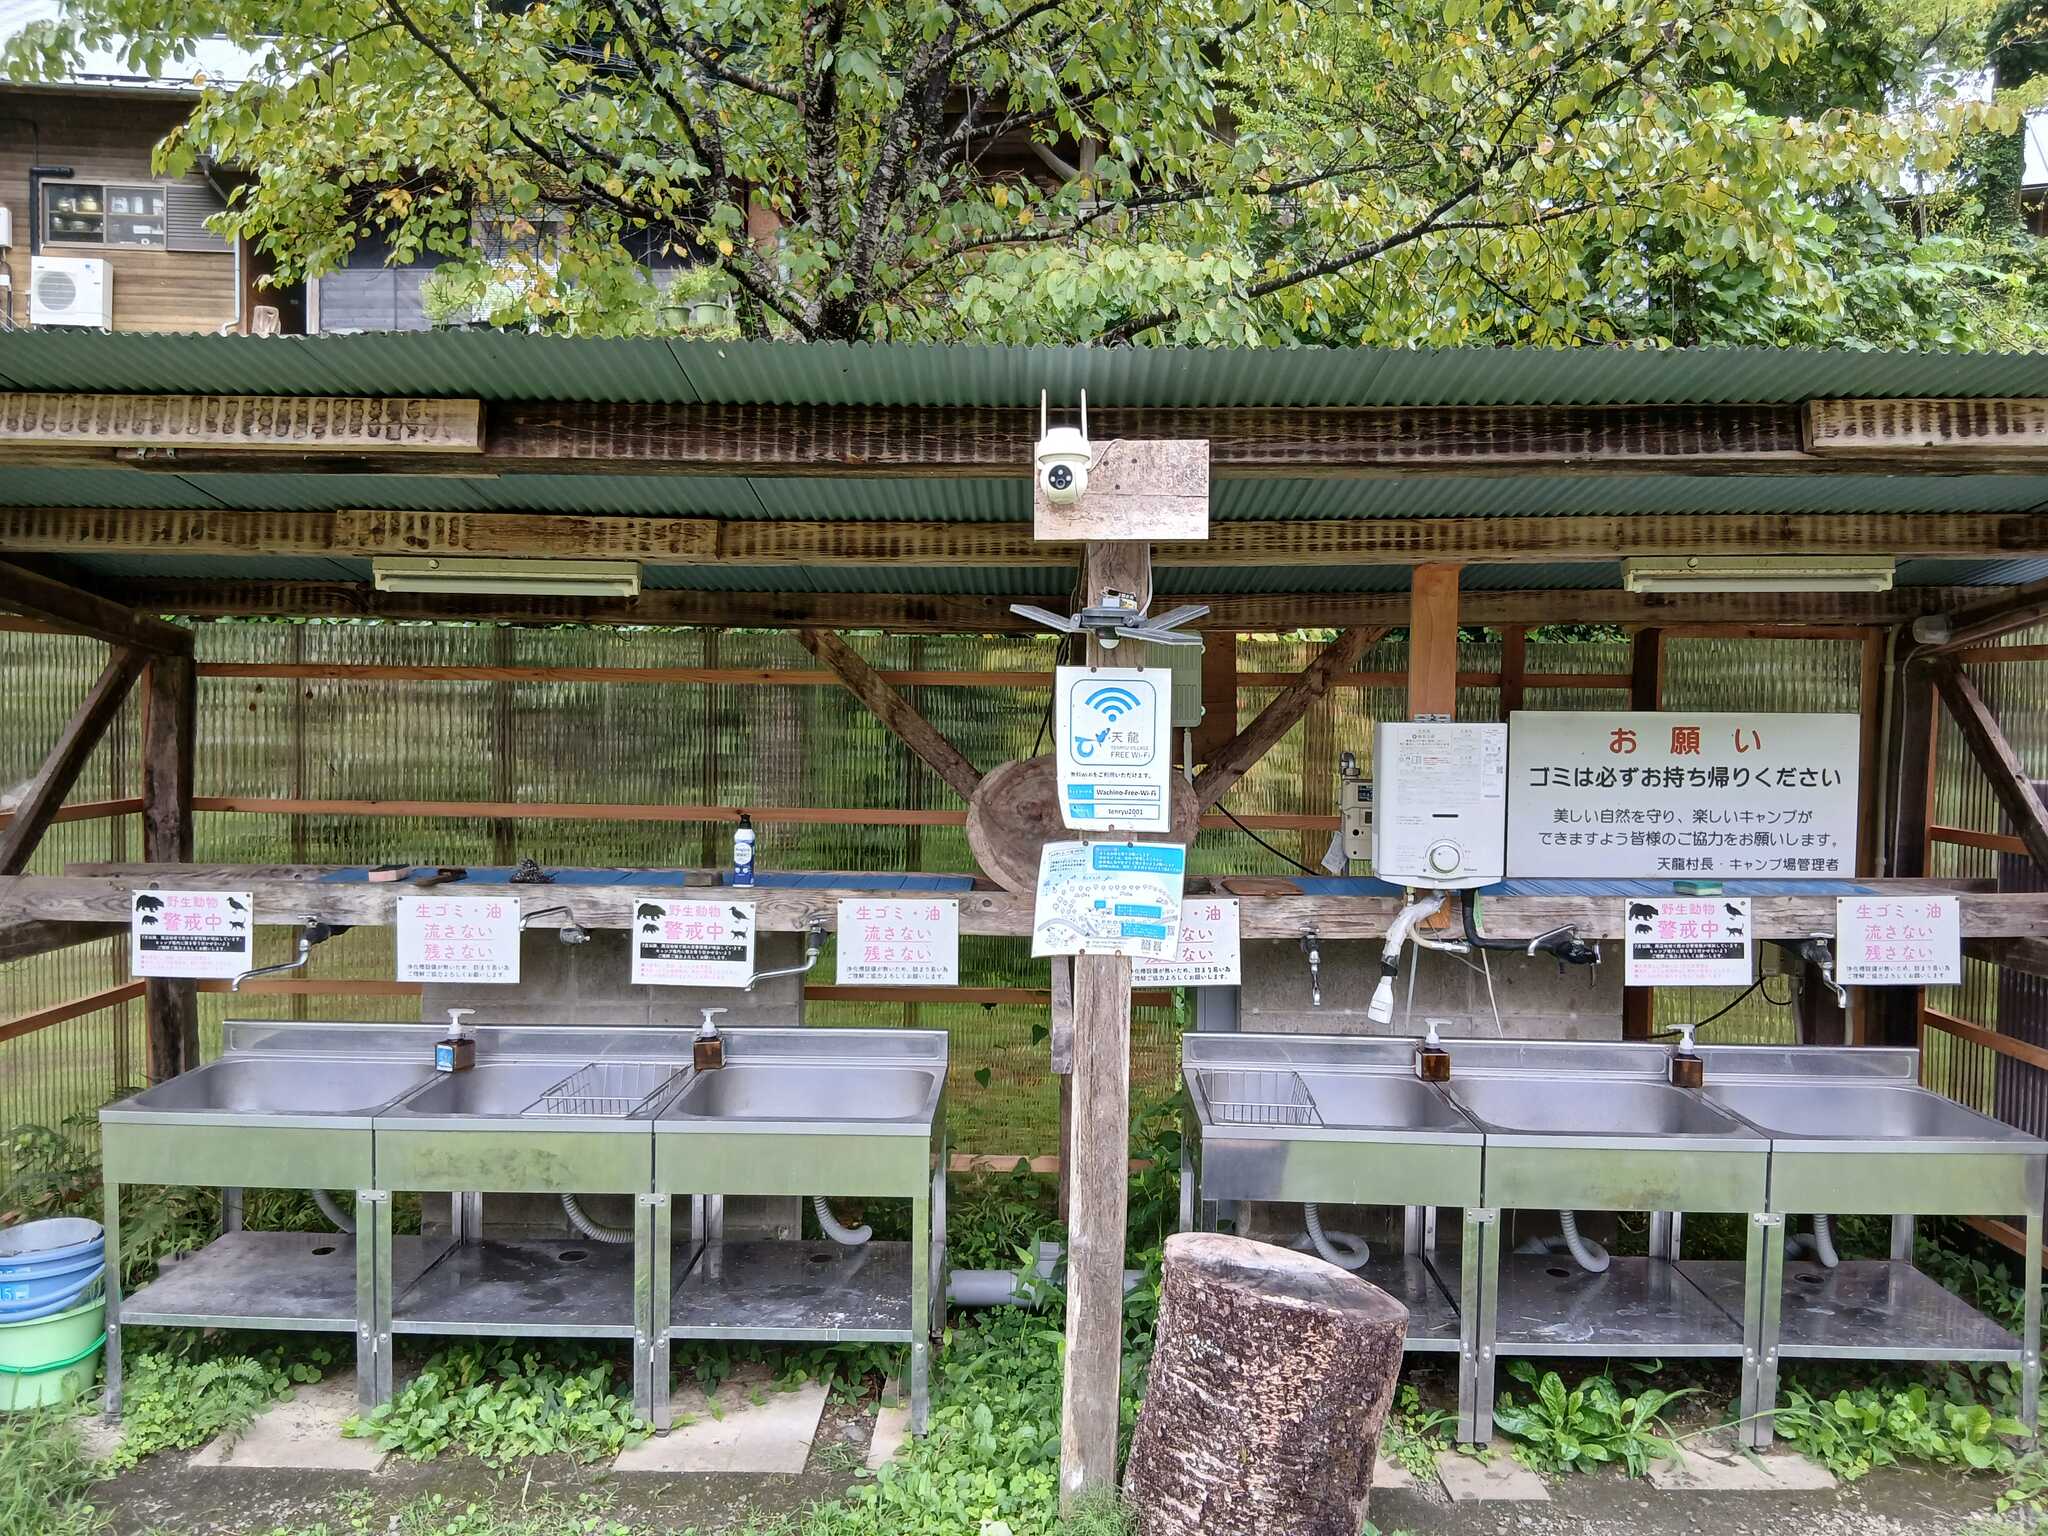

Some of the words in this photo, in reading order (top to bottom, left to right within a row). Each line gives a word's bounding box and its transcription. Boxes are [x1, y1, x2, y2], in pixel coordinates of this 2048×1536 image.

[1111, 731, 1139, 744] 天龍
[1609, 726, 1761, 755] お願い
[1529, 766, 1842, 789] ゴミは必ずお持ち帰りください
[1553, 808, 1813, 824] 美しい自然を守り、楽しいキャンプが
[1538, 831, 1838, 848] できますよう皆様のご協力をお願いします。
[1657, 857, 1839, 872] 天龍村長・キャンプ場管理者
[166, 895, 218, 908] 野生動物
[1661, 903, 1715, 916] 野生動物
[416, 903, 502, 919] 生ゴミ・油
[668, 904, 721, 917] 野生動物
[856, 905, 941, 921] 生ゴミ・油
[1856, 903, 1941, 919] 生ゴミ・油
[163, 912, 222, 931] 警戒中
[1657, 919, 1718, 939] 警戒中
[424, 923, 493, 939] 流さない
[664, 920, 724, 940] 警戒中
[864, 925, 932, 941] 流さない
[1864, 924, 1933, 940] 流さない
[424, 944, 493, 960] 残さない
[864, 946, 932, 961] 残さない
[1864, 945, 1933, 961] 残さない
